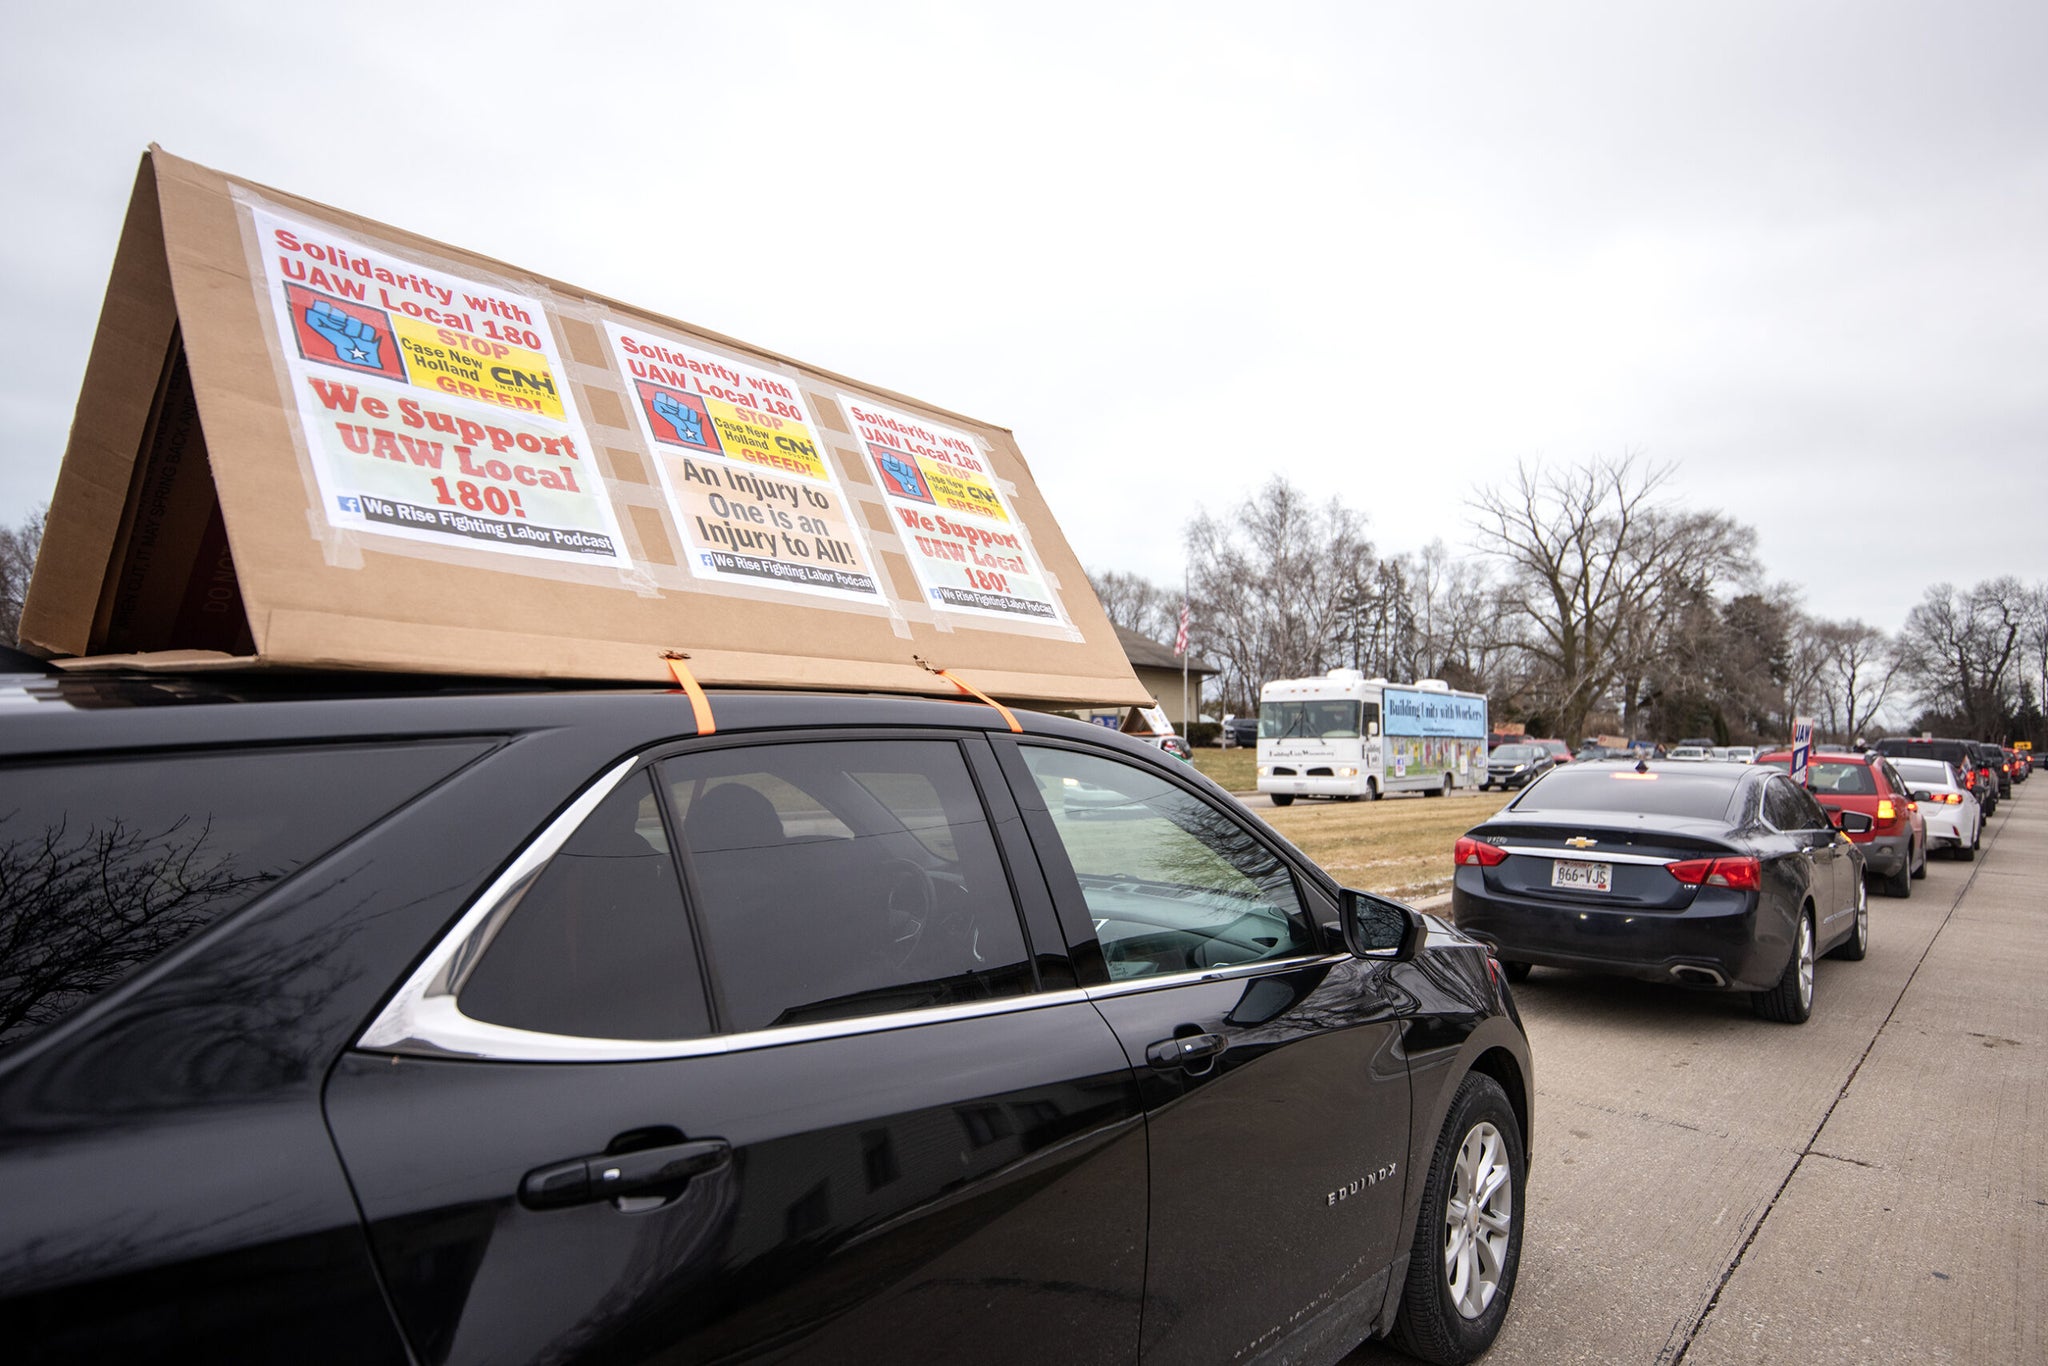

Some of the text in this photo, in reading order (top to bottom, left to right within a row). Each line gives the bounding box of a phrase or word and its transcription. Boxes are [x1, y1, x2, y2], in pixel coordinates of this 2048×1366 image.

[274, 229, 532, 325] Solidarity with
[279, 256, 542, 350] UAW Local 180
[401, 337, 483, 370] Case New
[437, 329, 510, 359] STOP
[414, 354, 480, 382] Holland
[620, 336, 793, 400] Solidarity with
[436, 376, 544, 414] GREED!
[495, 383, 557, 402] INDUSTRIAL
[627, 358, 803, 421] UAW Local 180
[307, 376, 579, 460] We Support
[714, 417, 770, 440] Case New
[735, 407, 784, 430] STOP
[851, 406, 974, 456] Solidarity with
[335, 422, 581, 493] UAW Local
[724, 429, 770, 451] Holland
[858, 425, 983, 473] UAW Local 180
[150, 464, 177, 515] SPRING
[167, 429, 187, 464] BACK
[741, 448, 814, 477] GREED!
[936, 462, 971, 481] STOP
[430, 476, 527, 519] 180!
[684, 458, 830, 510] An Injury to
[364, 497, 394, 517] We
[399, 504, 436, 524] Rise
[440, 509, 507, 539] Fighting
[508, 523, 551, 543] Labor
[553, 530, 613, 550] Podcast
[708, 492, 830, 537] One is an
[894, 506, 1022, 551] We Support
[695, 516, 857, 566] Injury to All!
[915, 535, 1030, 575] UAW Local
[714, 553, 734, 567] We
[735, 556, 761, 571] Rise
[762, 560, 806, 580] Fighting
[806, 568, 835, 583] Labor
[836, 572, 874, 589] Podcast
[964, 567, 1012, 594] 180!
[201, 587, 233, 613] DO
[940, 588, 956, 600] We
[956, 589, 974, 602] Rise
[1390, 699, 1420, 721] Building
[1440, 704, 1454, 719] with
[1455, 705, 1482, 720] Workers
